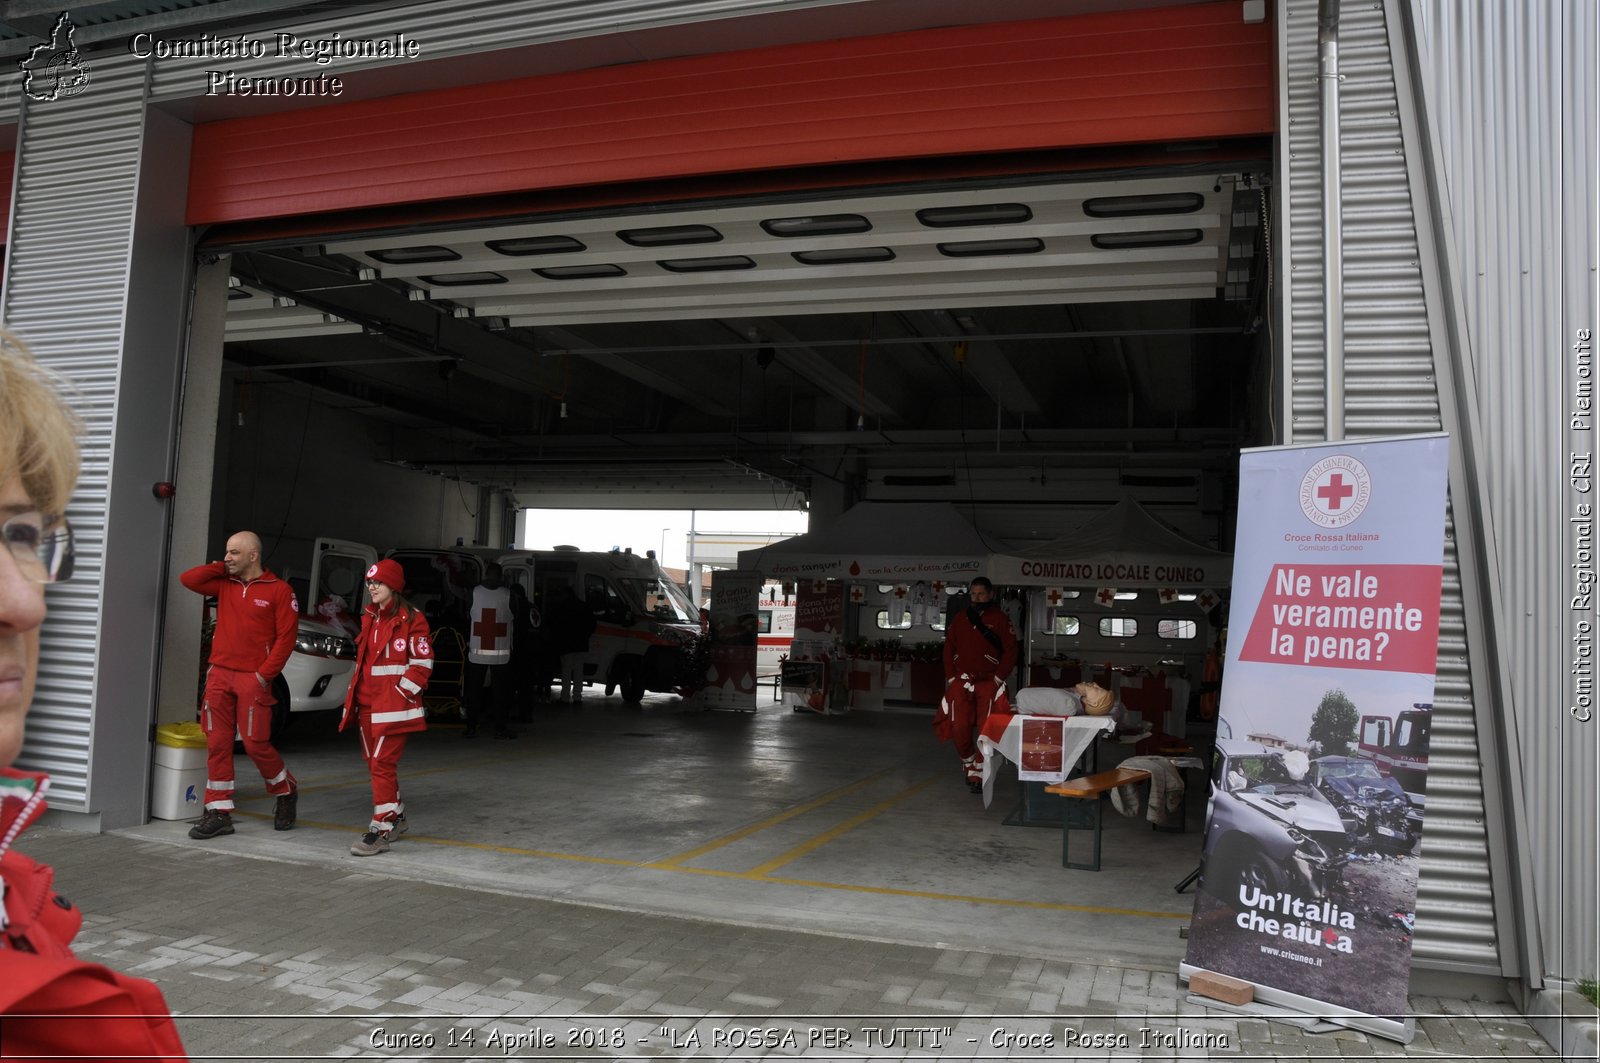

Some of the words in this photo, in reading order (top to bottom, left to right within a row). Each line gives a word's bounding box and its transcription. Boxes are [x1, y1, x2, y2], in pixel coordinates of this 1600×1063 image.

[1284, 533, 1312, 542] Croce
[1314, 533, 1344, 542] Rossa
[1346, 532, 1380, 542] Italiana
[1298, 544, 1330, 552] Comitato
[1331, 544, 1339, 552] di
[1340, 544, 1364, 552] Cuneo
[772, 563, 799, 574] dona
[893, 564, 916, 573] Croce
[952, 560, 980, 570] CUNEO
[1021, 561, 1093, 580] COMITATO
[1097, 564, 1150, 581] LOCALE
[1155, 566, 1205, 583] CUNEO
[1276, 568, 1311, 597] Ne
[1321, 570, 1379, 598] vale
[1272, 602, 1422, 631] veramente
[1270, 627, 1294, 656] la
[1304, 632, 1390, 664] pena?
[1236, 910, 1280, 936] che
[1260, 945, 1323, 968] www.cricuneo.it
